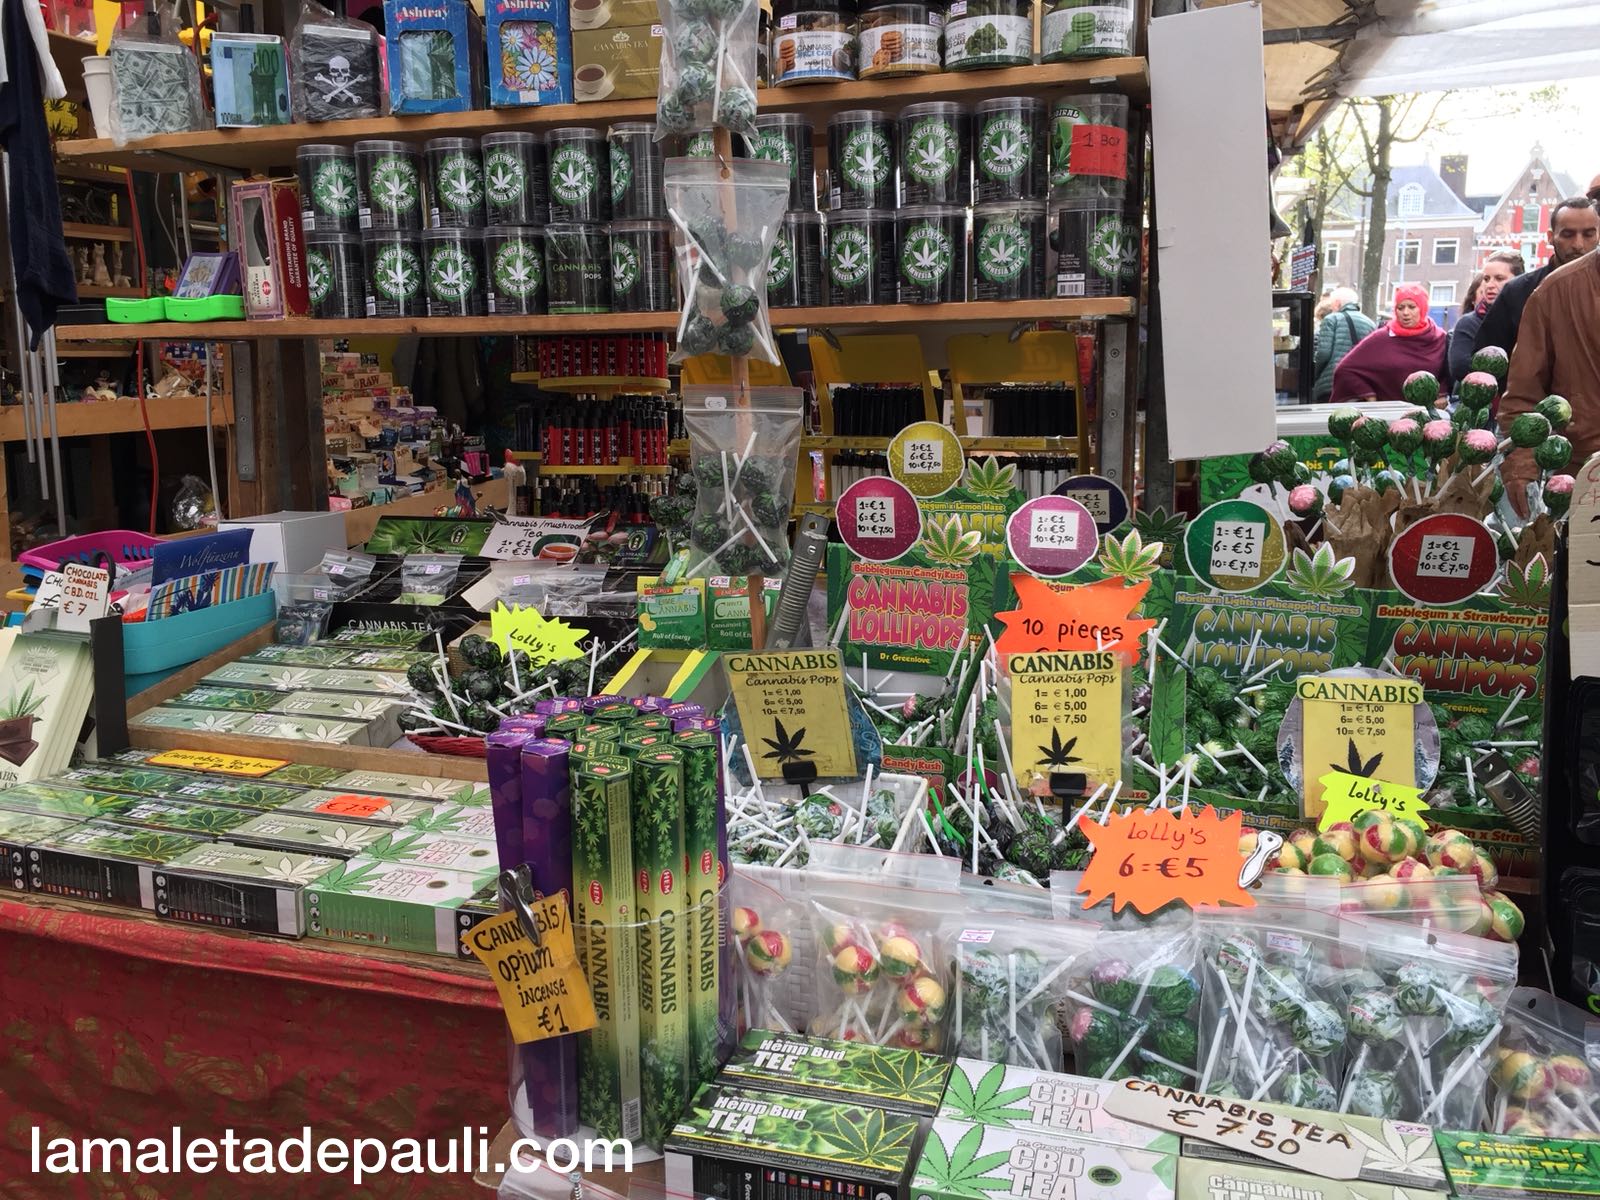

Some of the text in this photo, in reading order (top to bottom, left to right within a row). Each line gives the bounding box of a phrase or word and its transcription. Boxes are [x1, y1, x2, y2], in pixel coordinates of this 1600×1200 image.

[399, 6, 449, 20] Ashtray
[500, 0, 551, 12] Ashtray
[593, 40, 648, 51] CANNABIS TEA
[797, 43, 832, 51] CANNABIS
[1083, 132, 1094, 147] 1
[283, 219, 296, 285] OUTSTANDING BRAND
[288, 216, 302, 288] GUARANTEE QUALITY
[552, 263, 601, 272] CANNABIS
[955, 502, 1006, 511] Lemon Haze
[523, 528, 543, 538] Tea
[66, 566, 108, 581] CHOCOLATE
[853, 563, 966, 581] Bubblegum Candy Kush
[67, 576, 98, 589] CANNABIS
[848, 575, 969, 617] CANNABIS
[1175, 591, 1362, 616] Northern Lights Pineapple Express
[647, 601, 697, 616] CANNABIS
[1378, 606, 1535, 626] Bubblegum Strawberry
[348, 619, 435, 632] CANNABIS TEA
[848, 609, 969, 651] LOLLIPOPS
[1022, 618, 1124, 642] 10 pieces
[1193, 608, 1338, 653] CANNABIS
[671, 633, 691, 641] Energy
[1394, 622, 1547, 666] CANNABIS
[729, 653, 837, 673] CANNABIS
[893, 654, 931, 664] Greenlove
[1010, 652, 1114, 674] CANNABIS
[745, 674, 839, 687] Cannabis Pops
[1019, 672, 1116, 686] Cannabis Pops
[1394, 655, 1540, 700] LOLLIPOPS
[784, 688, 801, 697] 1,00
[786, 698, 803, 706] 5,00
[1035, 688, 1048, 698] 1=
[1064, 688, 1087, 699] 1,00
[1299, 681, 1419, 704] CANNABIS
[788, 707, 806, 715] 7,50
[1034, 701, 1048, 711] 6=
[1064, 701, 1087, 712] 5,00
[1341, 704, 1353, 712] 1=
[1366, 704, 1384, 714] 1,00
[1029, 714, 1048, 724] 10=
[1064, 714, 1087, 725] 7,50
[1340, 715, 1353, 724] 6=
[1366, 716, 1385, 725] 5,00
[1336, 727, 1353, 735] 10=
[1366, 727, 1385, 737] 7,50
[163, 751, 224, 763] Cannabis
[884, 757, 942, 772] Candy Kush
[253, 824, 287, 835] TEA
[189, 855, 230, 867] TEE
[702, 850, 712, 875] HEM
[381, 868, 433, 886] CBD
[641, 869, 649, 893] HEM
[662, 870, 672, 894] HEM
[367, 880, 417, 898] TEA
[591, 881, 602, 905] HEM
[699, 888, 715, 992] CANNABIS
[590, 918, 610, 1021] CANNABIS
[639, 907, 654, 1013] CANNABIS
[659, 909, 677, 1014] CANNABIS
[537, 1003, 570, 1033] €1
[759, 1038, 846, 1061] Hemp Bud
[752, 1050, 799, 1073] TEE
[1028, 1081, 1100, 1111] CBD
[714, 1095, 807, 1120] Hemp Bud
[1028, 1100, 1093, 1133] TEA
[1125, 1079, 1352, 1150] CANNABIS TEA
[706, 1109, 758, 1135] TEA
[1167, 1108, 1205, 1128] €
[1008, 1145, 1085, 1178] CBD
[1456, 1141, 1587, 1163] Cannabis
[1008, 1167, 1077, 1200] TEA
